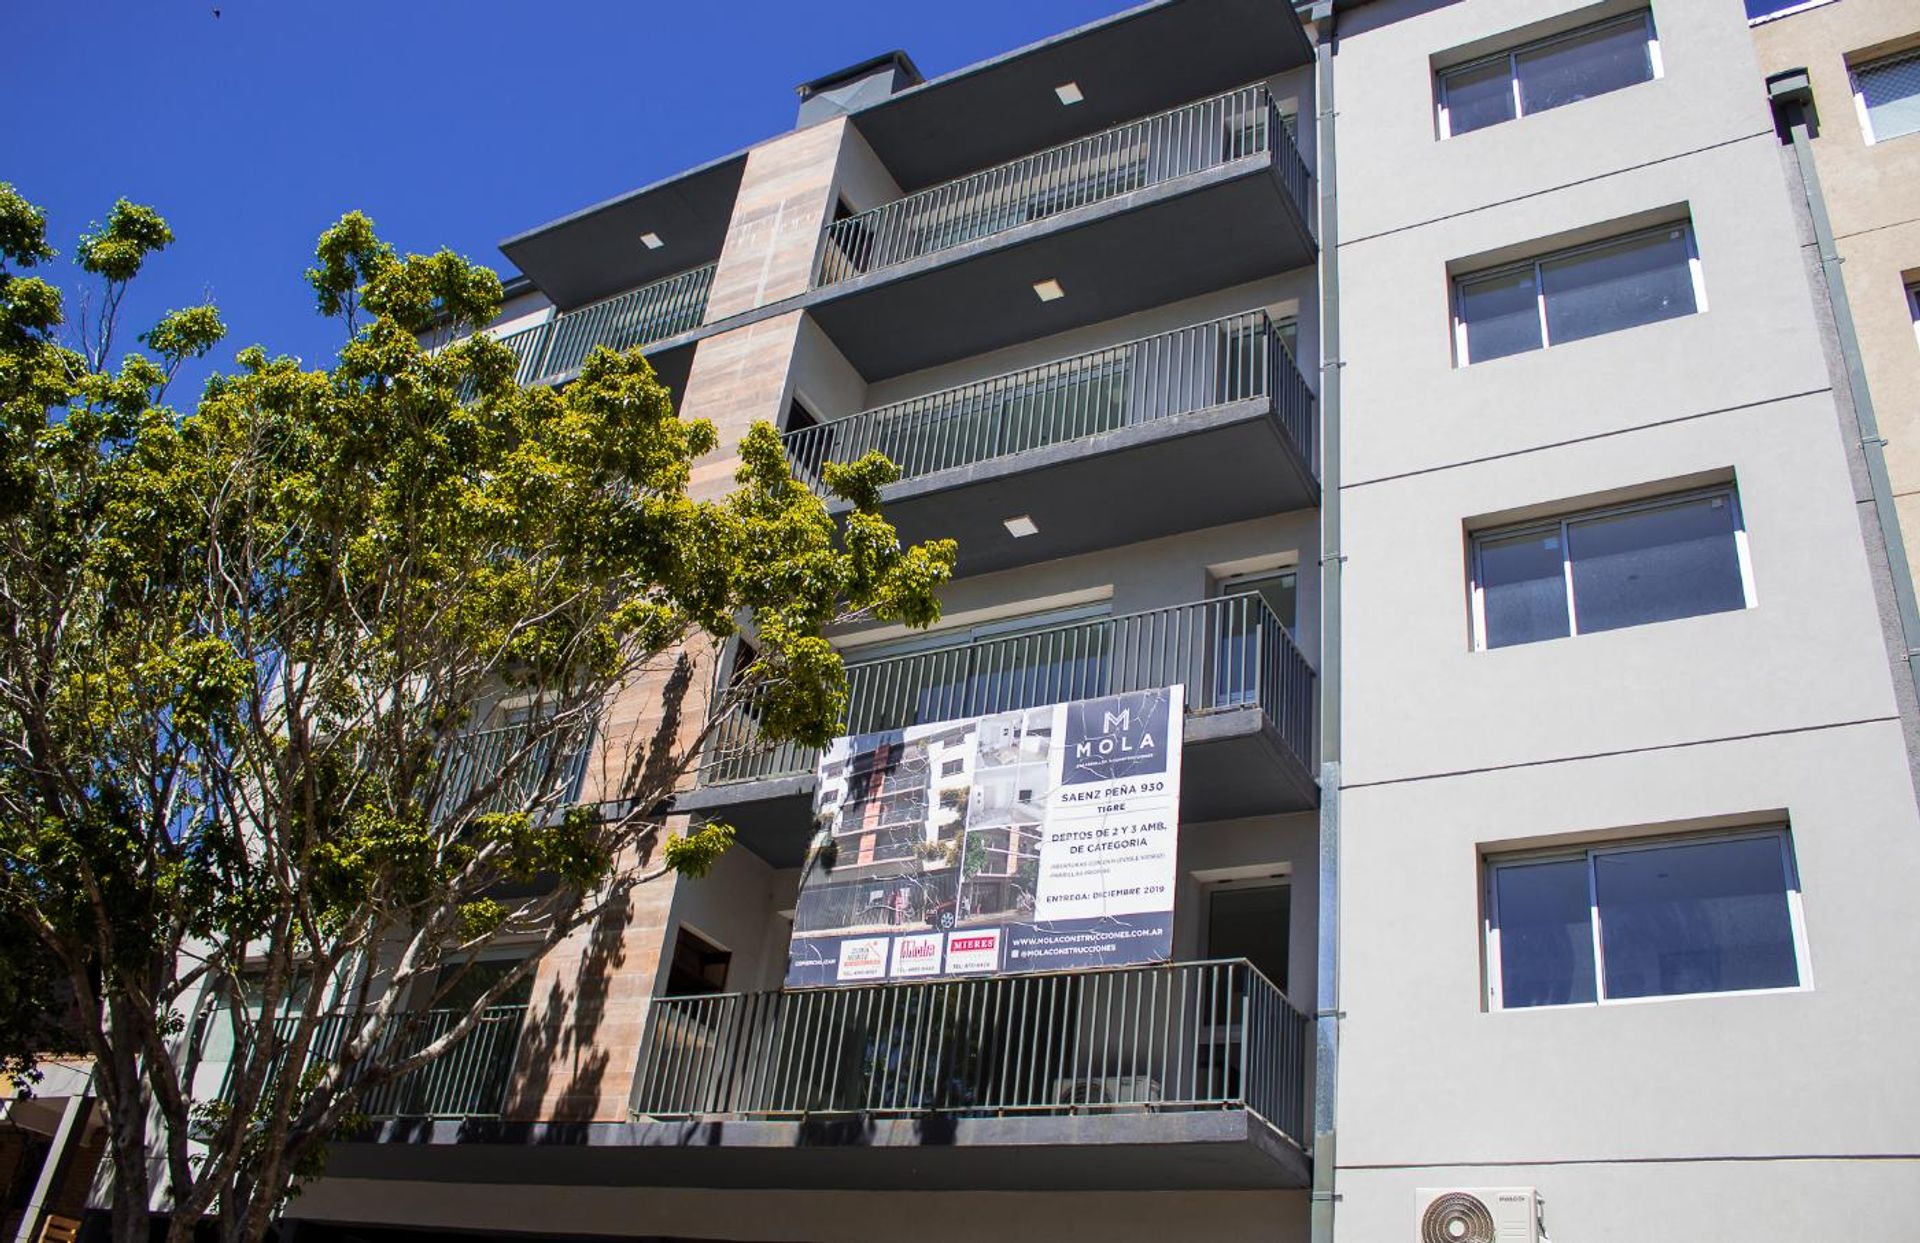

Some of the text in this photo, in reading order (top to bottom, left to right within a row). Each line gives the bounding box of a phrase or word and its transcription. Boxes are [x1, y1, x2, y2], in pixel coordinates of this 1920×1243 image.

[1076, 733, 1155, 758] MOLA
[1061, 790, 1102, 802] SAENZ
[1105, 784, 1136, 798] PEÑA
[1097, 803, 1126, 813] TIGRE
[1051, 822, 1167, 842] DEPTOS DE 2 Y 3 AMB.
[1070, 838, 1148, 855] DE CATEGORIA
[1046, 885, 1165, 903] ENTREGA: DICIEMBRE 2019
[953, 939, 994, 949] MIERES
